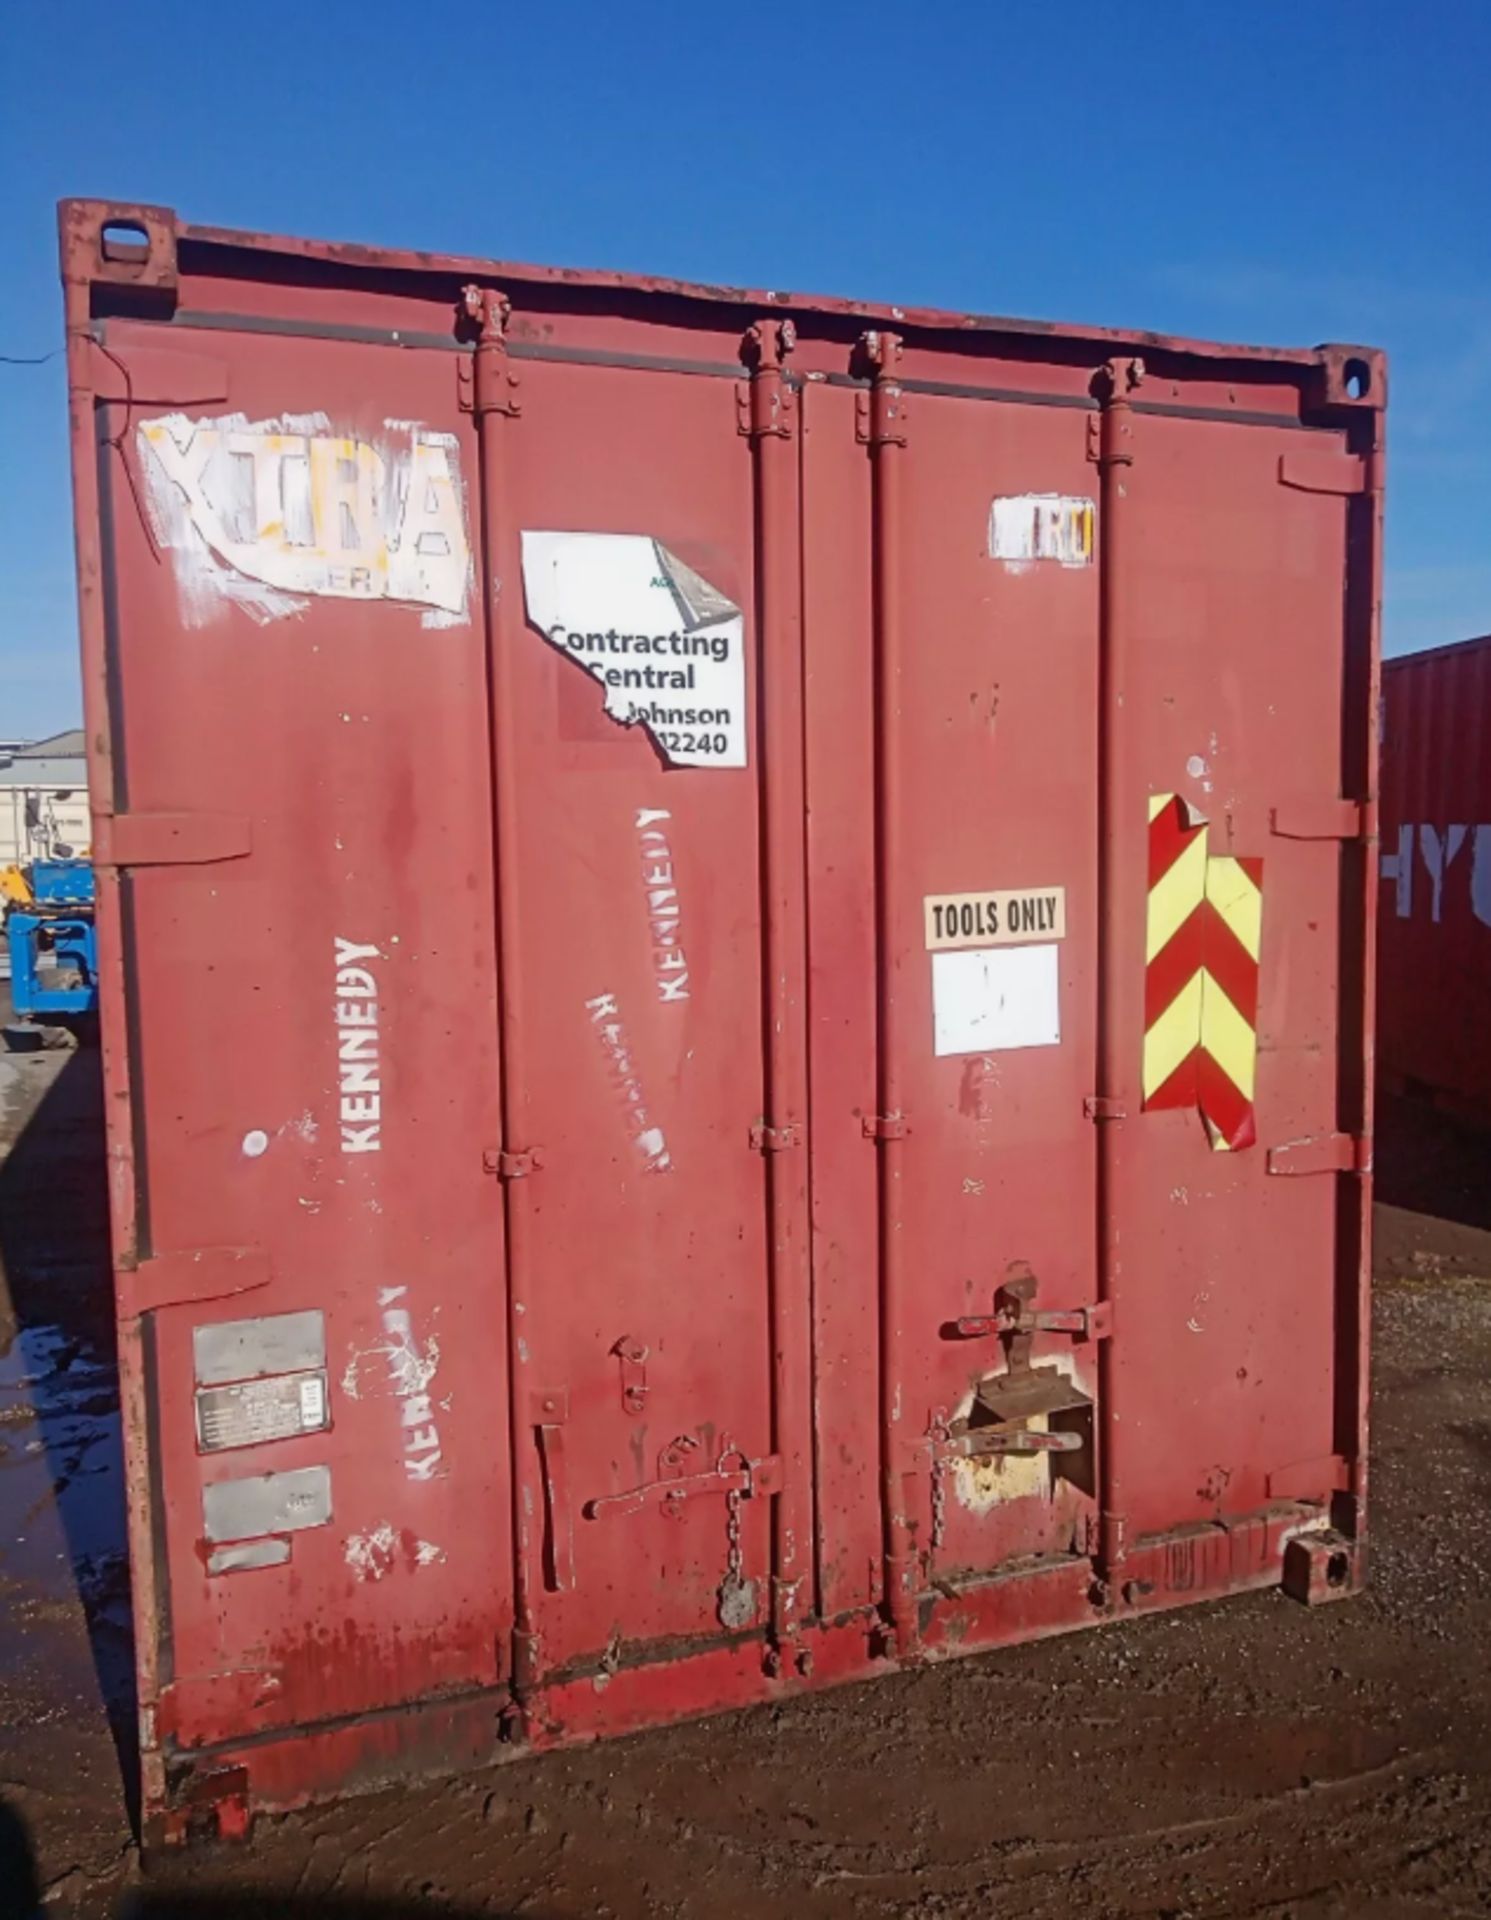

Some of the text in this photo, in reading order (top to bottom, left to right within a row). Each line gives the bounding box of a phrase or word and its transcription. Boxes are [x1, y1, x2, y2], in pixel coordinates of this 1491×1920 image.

[549, 624, 729, 662] Contracting
[932, 896, 1056, 938] TOOLS ONLY
[334, 936, 381, 1152] KENNEDY
